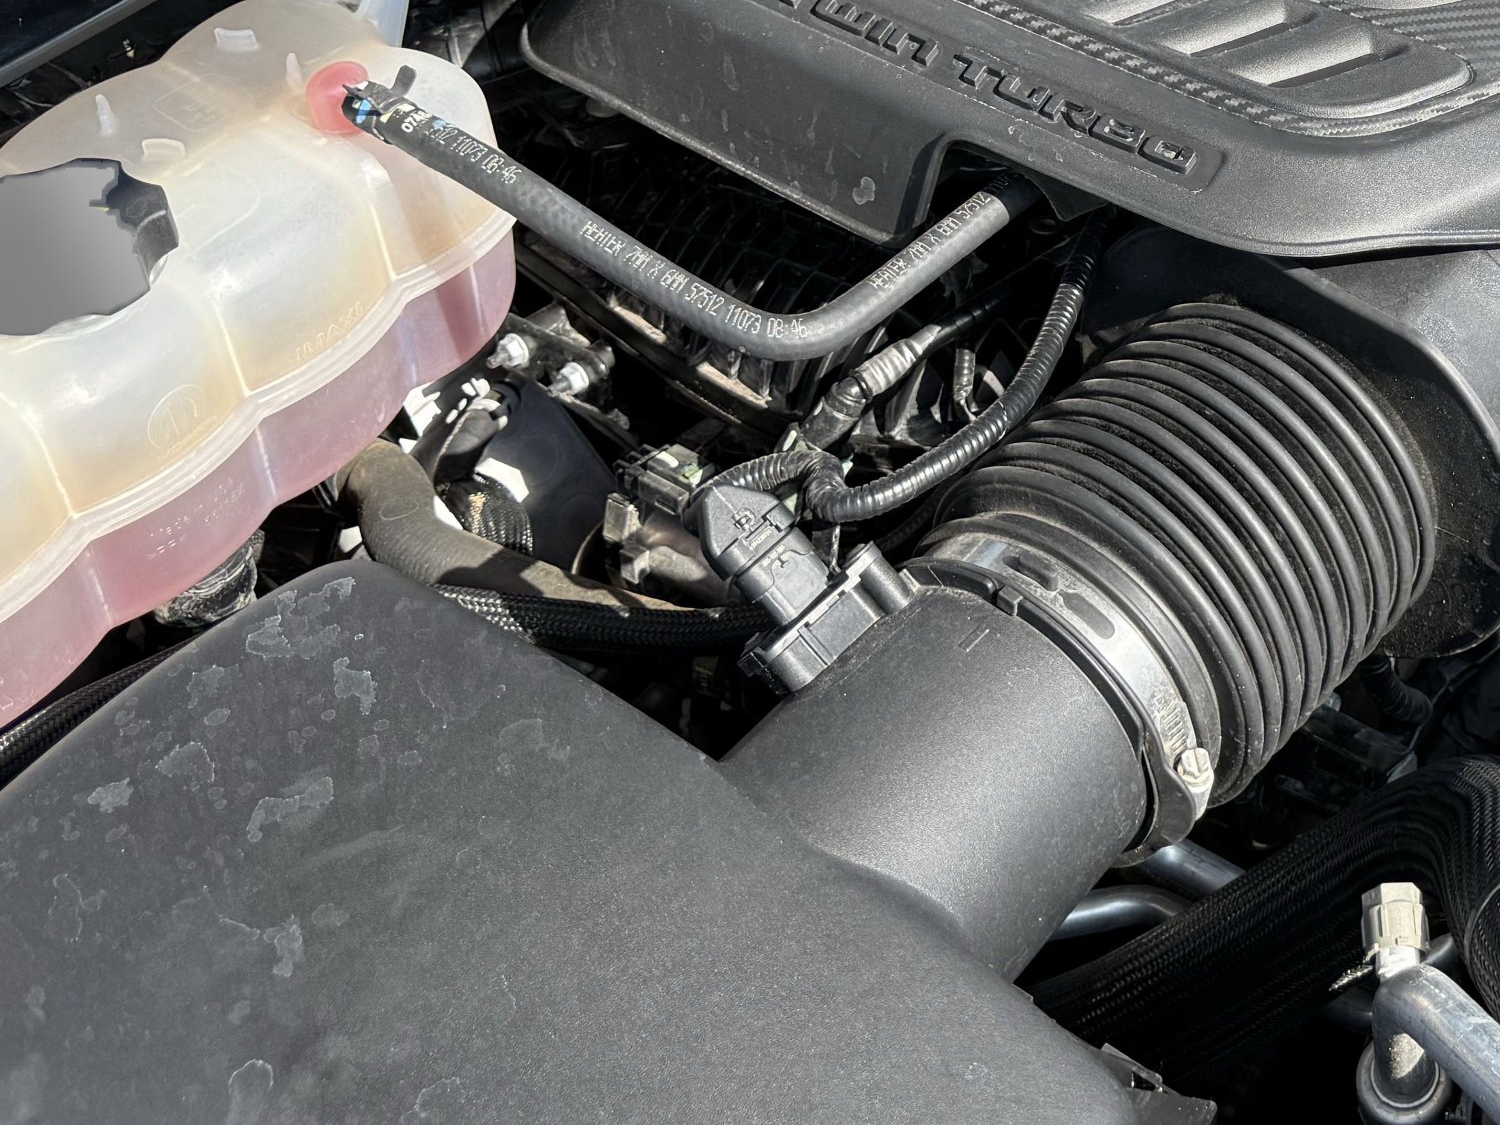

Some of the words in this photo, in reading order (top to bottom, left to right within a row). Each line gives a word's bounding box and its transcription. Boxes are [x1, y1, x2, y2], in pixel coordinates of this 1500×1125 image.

[953, 53, 1198, 174] TURBO
[684, 282, 725, 316] 57512
[725, 304, 762, 335] 11073
